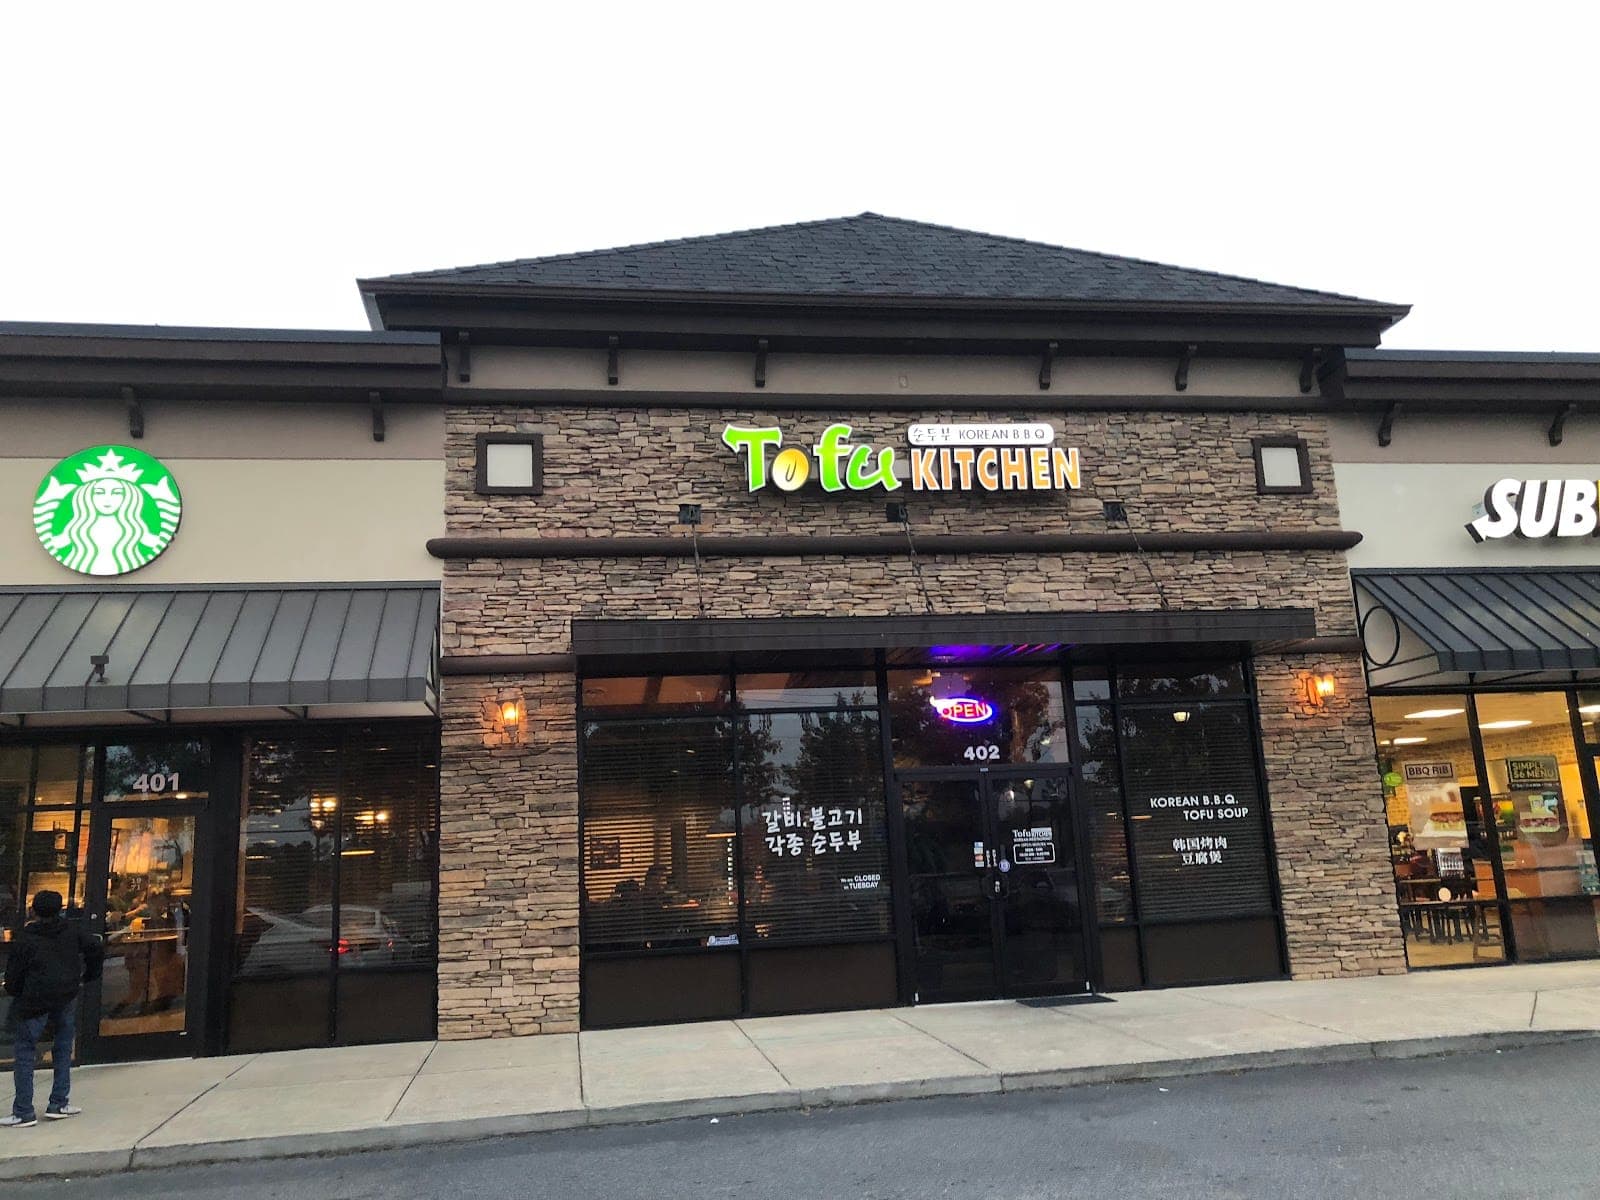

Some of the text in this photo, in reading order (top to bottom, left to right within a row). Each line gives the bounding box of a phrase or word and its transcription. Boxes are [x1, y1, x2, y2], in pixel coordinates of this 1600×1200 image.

[959, 428, 1008, 440] KOREAN
[722, 423, 1080, 492] Tofu KITCHEN
[1471, 478, 1600, 541] SUB
[942, 703, 986, 718] OPEN
[963, 744, 1001, 760] 402
[1408, 765, 1449, 776] BBQ RIB
[1512, 761, 1545, 769] SIMPLE
[1527, 767, 1554, 779] MENU
[132, 772, 180, 792] 401
[1150, 796, 1200, 809] KOREAN
[809, 806, 863, 832] 불고기
[1183, 807, 1249, 821] TOFU SOUP
[765, 829, 862, 857] 각종 순두부
[854, 873, 881, 882] CLOSED
[849, 881, 879, 890] TUESDAY
